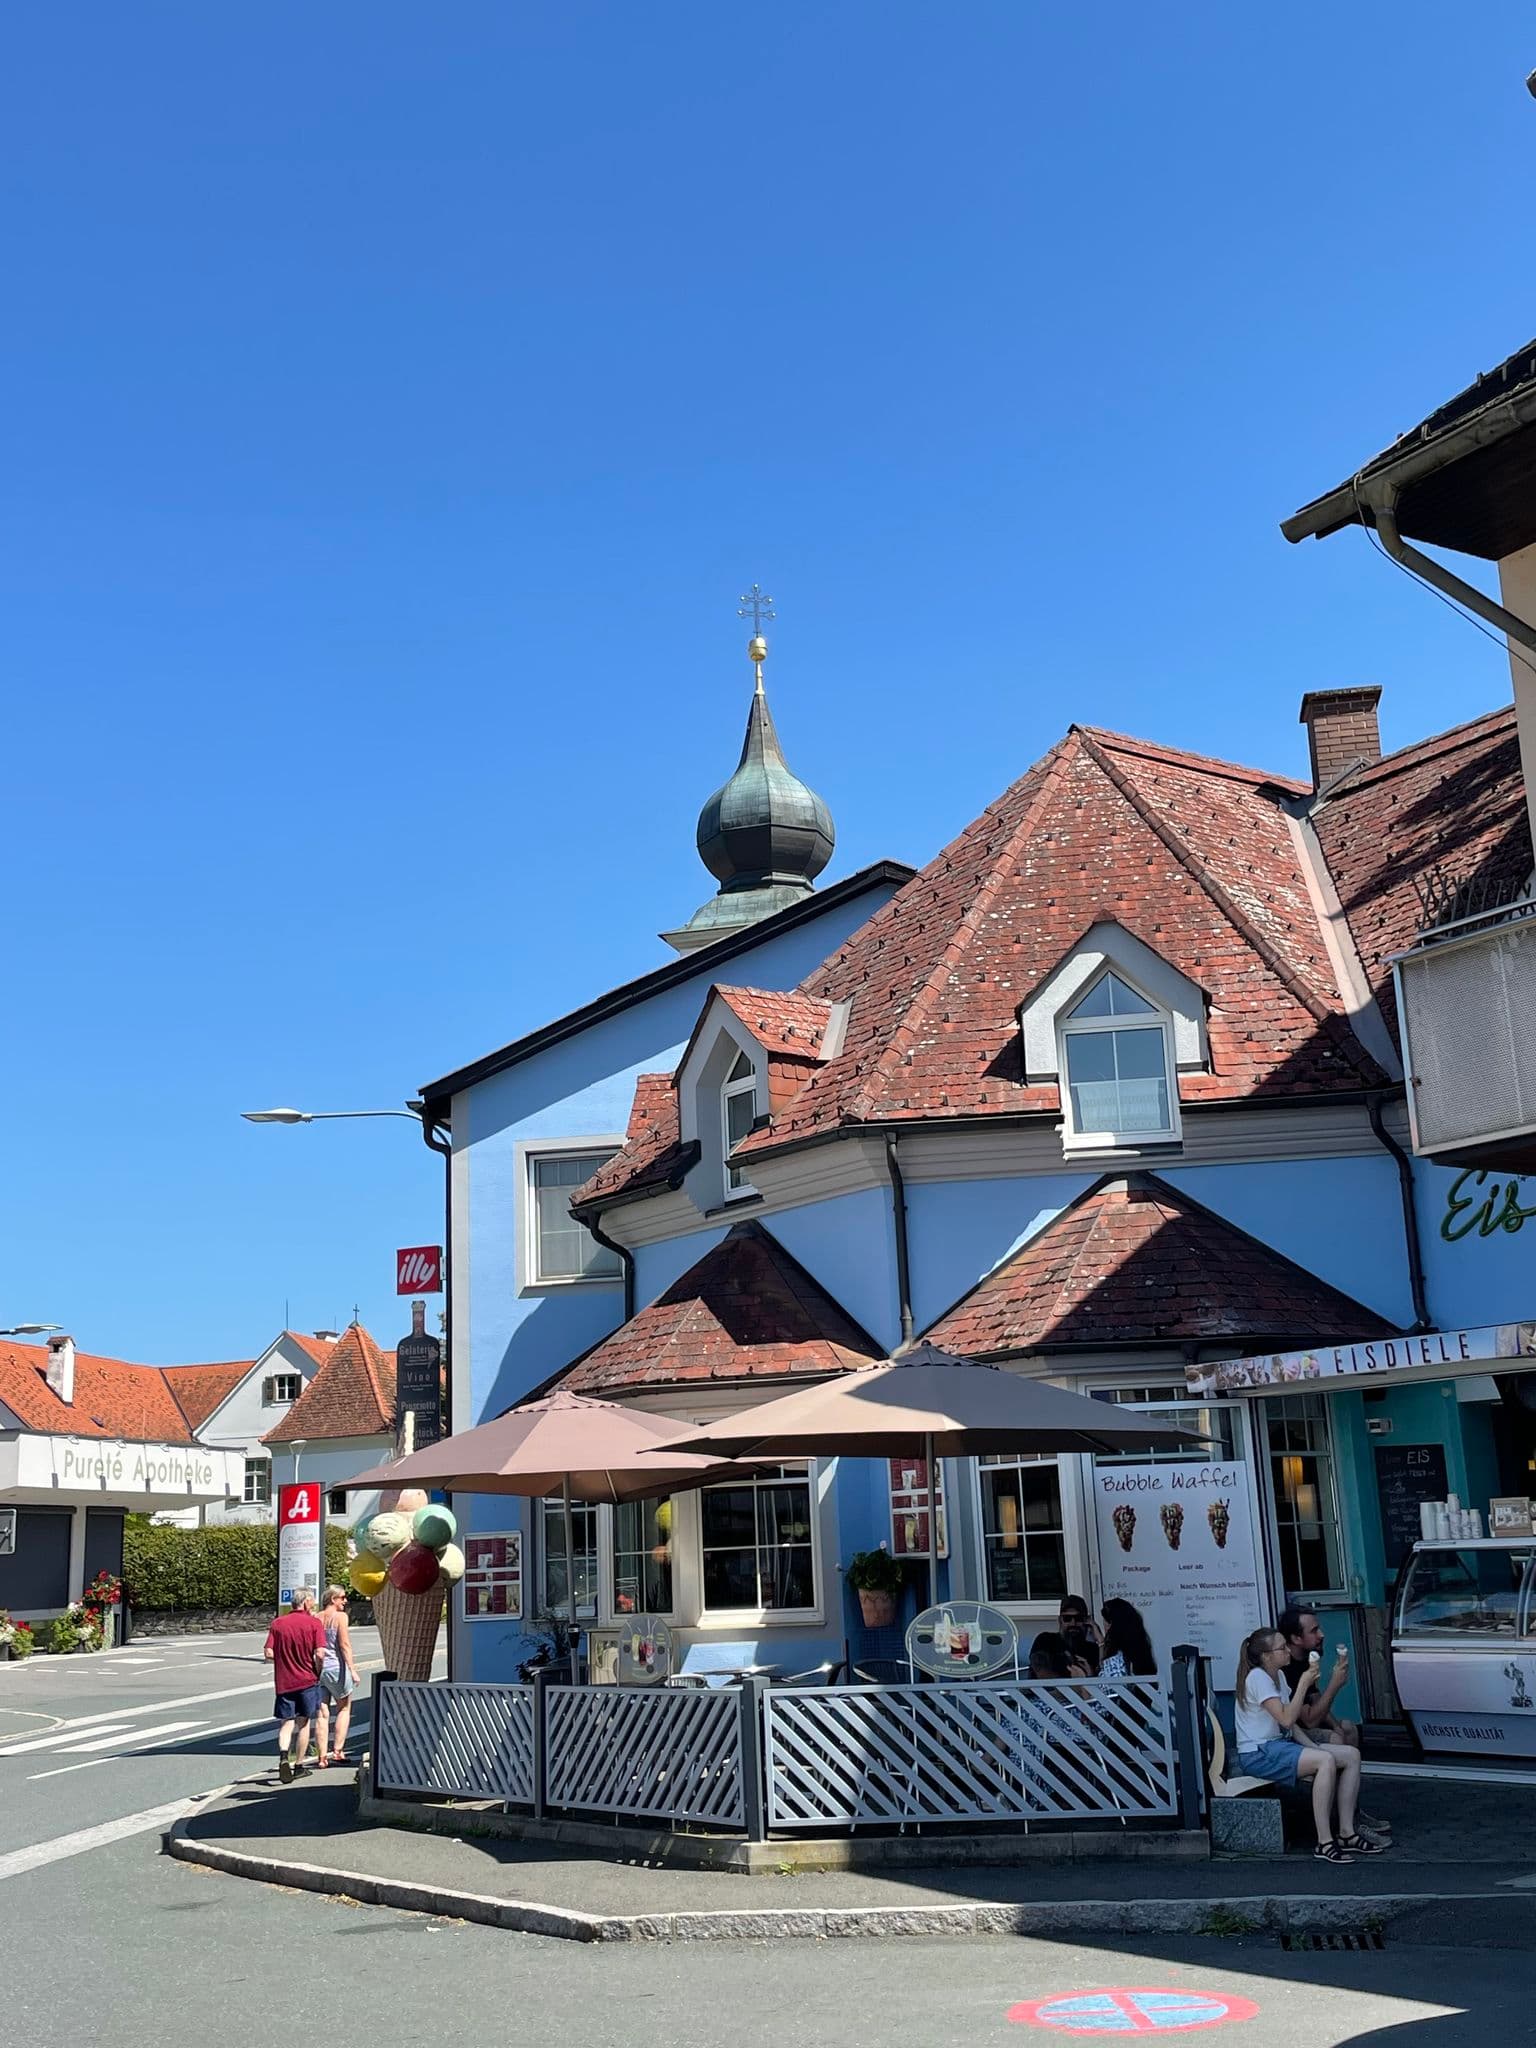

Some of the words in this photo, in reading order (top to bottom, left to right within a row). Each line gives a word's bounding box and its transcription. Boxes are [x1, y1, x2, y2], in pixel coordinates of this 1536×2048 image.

[1441, 1169, 1536, 1242] Eis
[399, 1253, 436, 1290] illy
[1334, 1333, 1470, 1374] EISDIELE
[407, 1371, 430, 1383] Vino
[64, 1449, 123, 1480] Pureté
[133, 1455, 212, 1485] Apotheke
[1407, 1449, 1430, 1465] EIS
[1101, 1473, 1163, 1492] Bubble
[1171, 1467, 1238, 1489] Waffel
[1421, 1723, 1462, 1738] HÖCHSTE
[1462, 1726, 1505, 1740] QUALITÄT
